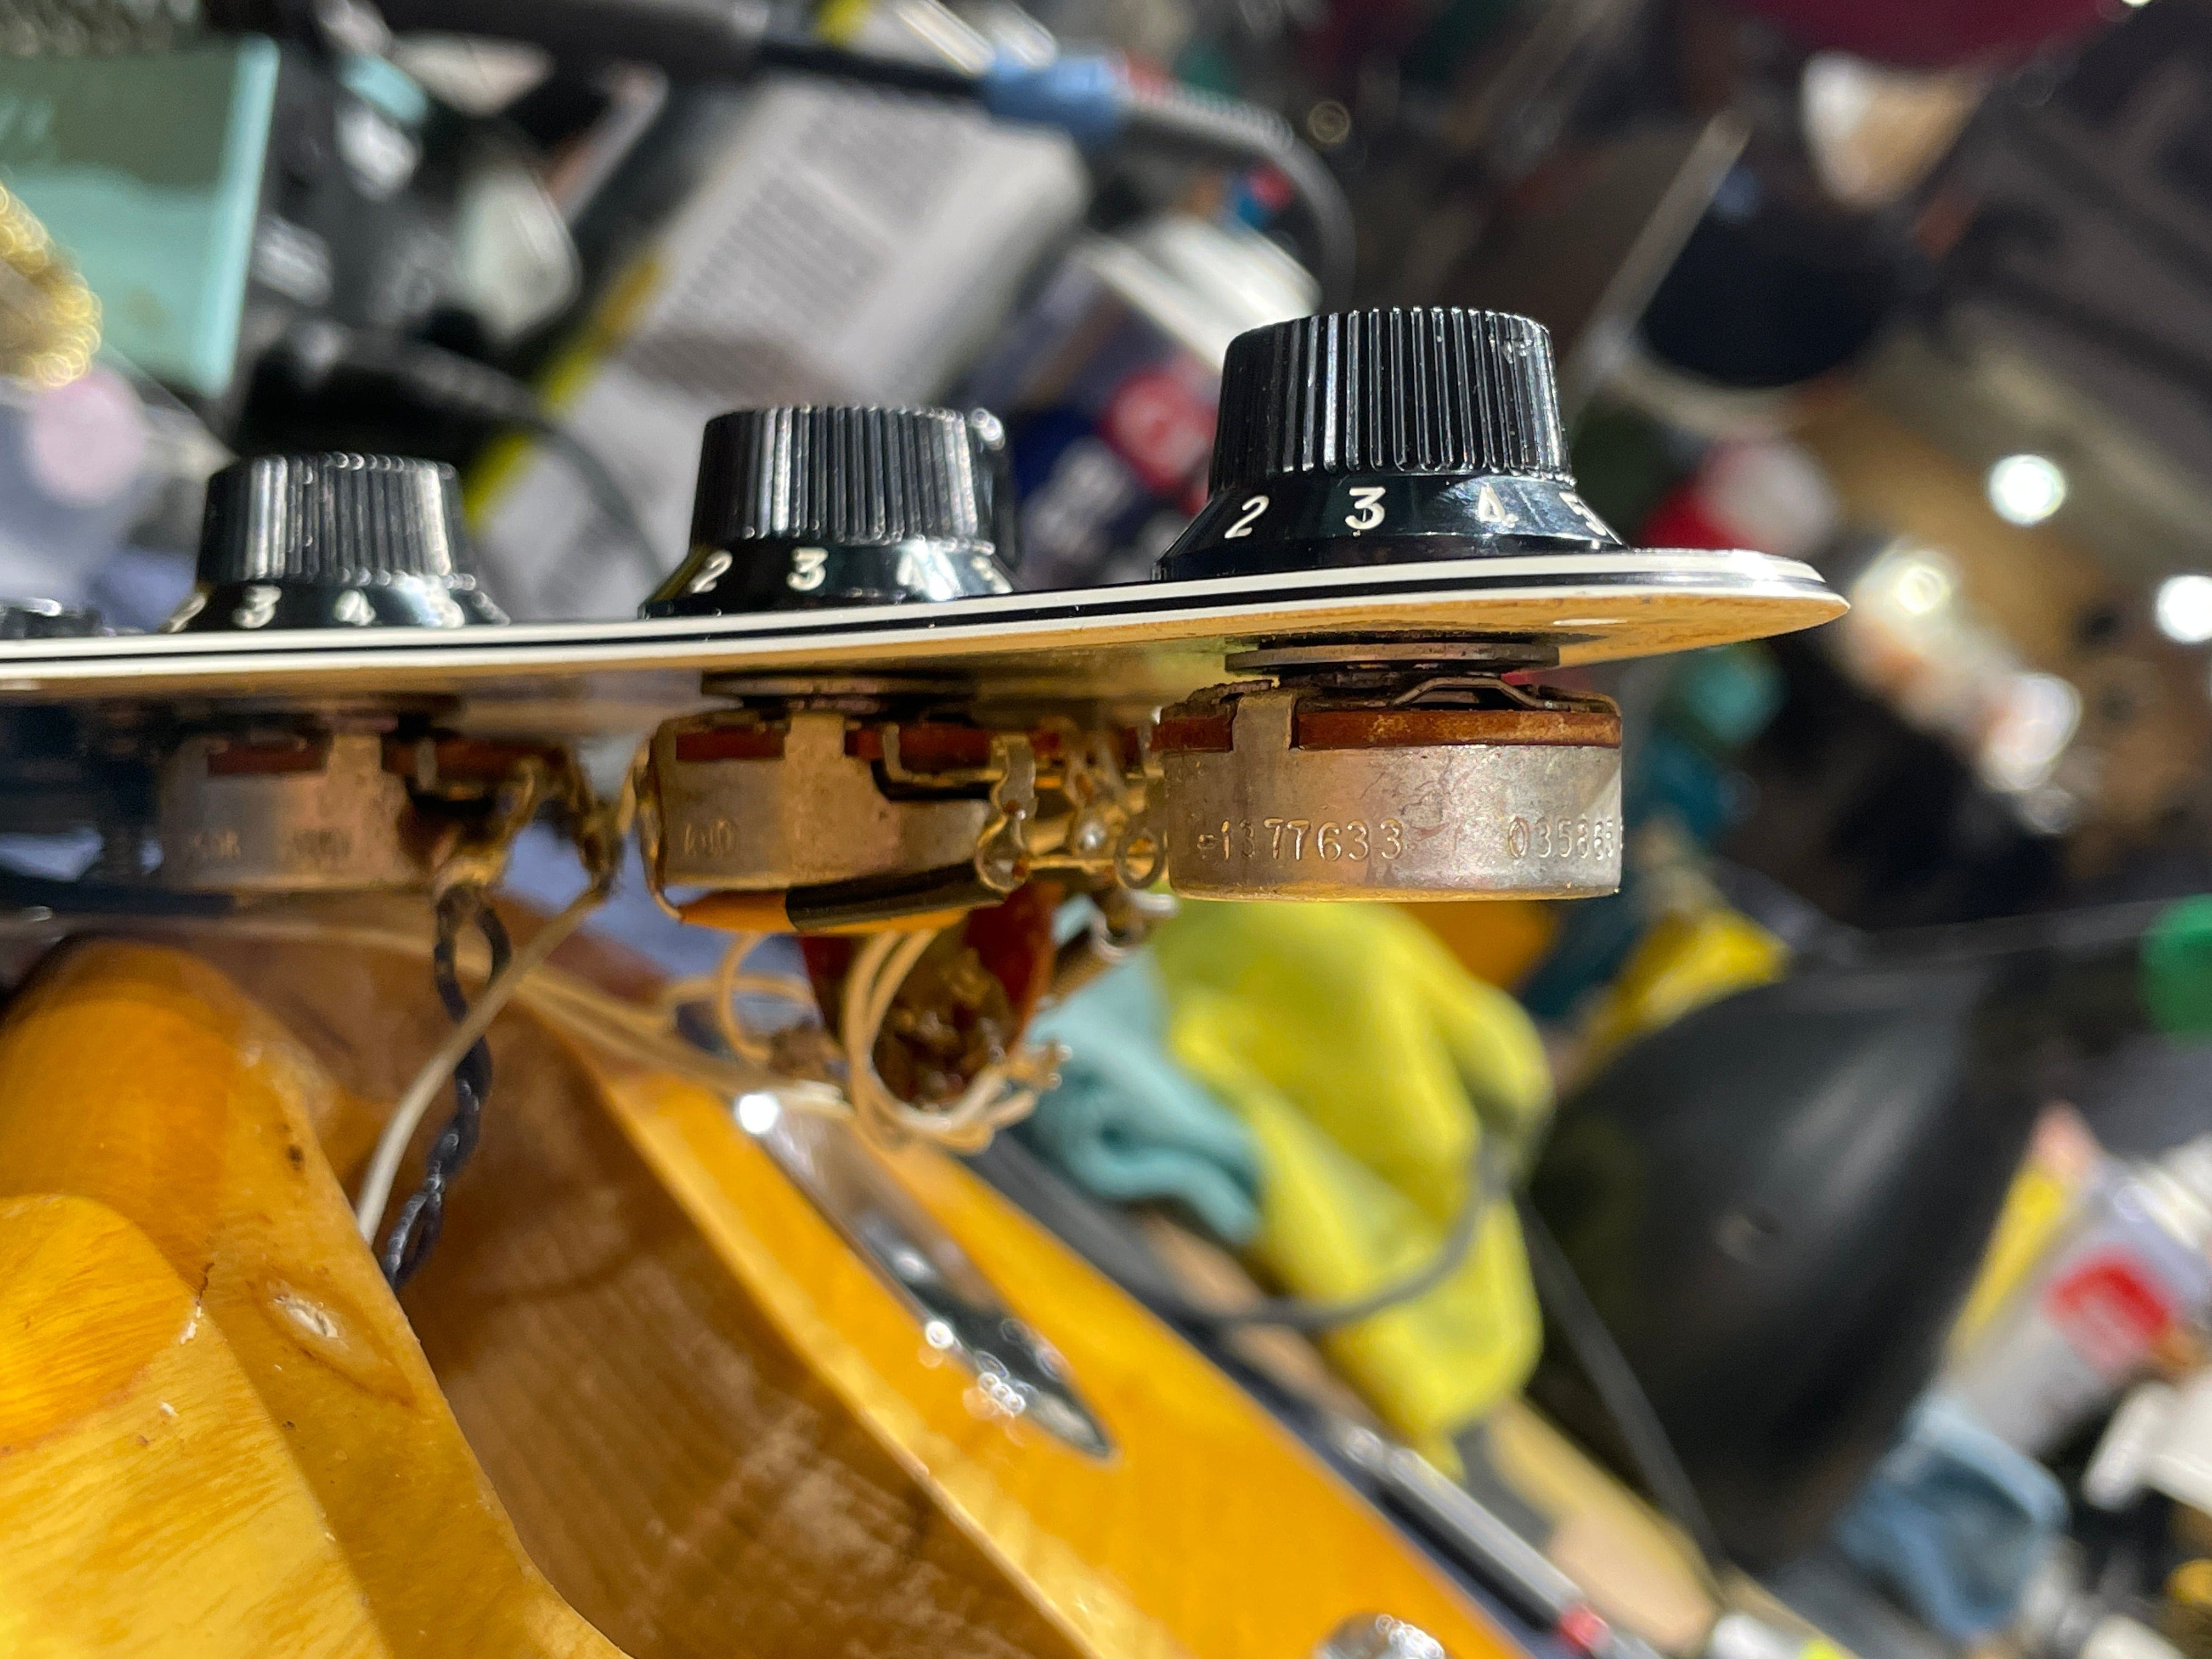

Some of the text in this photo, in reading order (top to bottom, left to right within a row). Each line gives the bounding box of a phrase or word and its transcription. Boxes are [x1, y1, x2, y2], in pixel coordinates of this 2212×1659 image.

[1224, 494, 1271, 539] 2
[1345, 486, 1387, 531] 3
[1477, 483, 1519, 528] 4
[689, 549, 733, 594] 2
[786, 547, 829, 591] 3
[232, 584, 283, 629] 3
